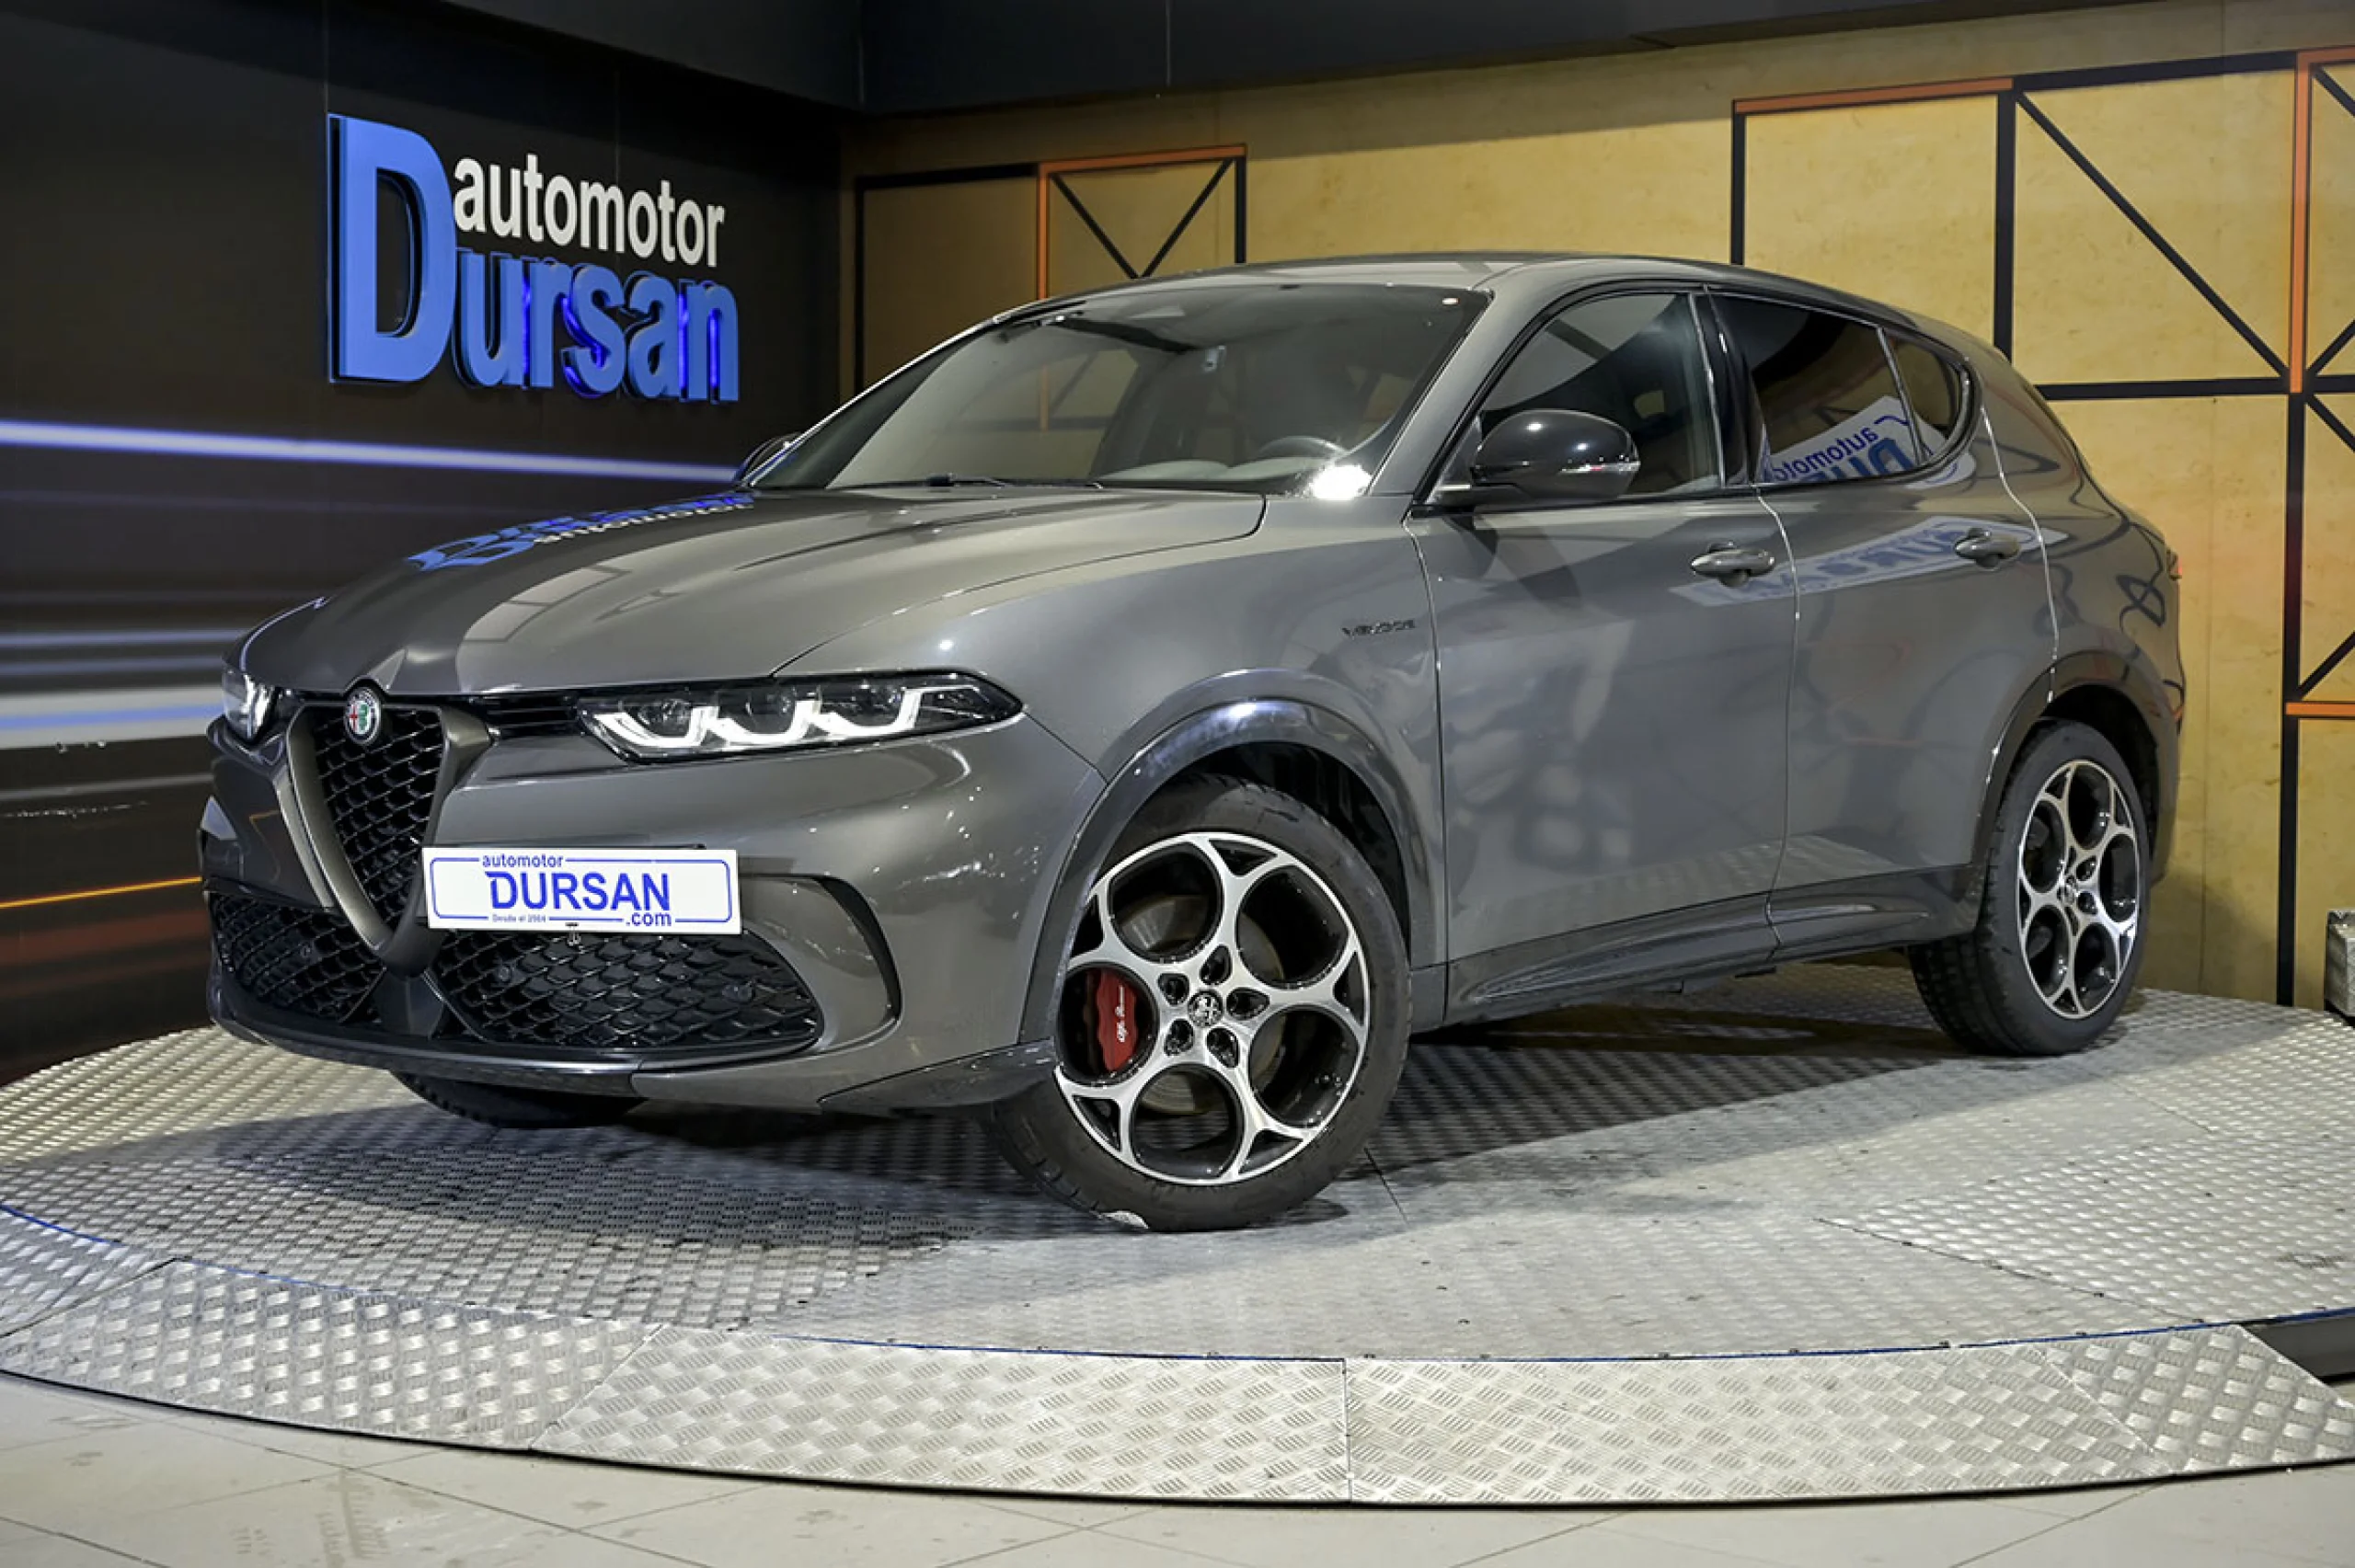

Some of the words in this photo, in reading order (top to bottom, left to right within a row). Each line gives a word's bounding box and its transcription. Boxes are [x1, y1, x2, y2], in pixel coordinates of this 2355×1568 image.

[454, 154, 726, 268] automotor
[327, 113, 740, 404] Dursan
[482, 853, 564, 868] automotor
[484, 871, 671, 911] DURSAN
[625, 910, 672, 927] .com
